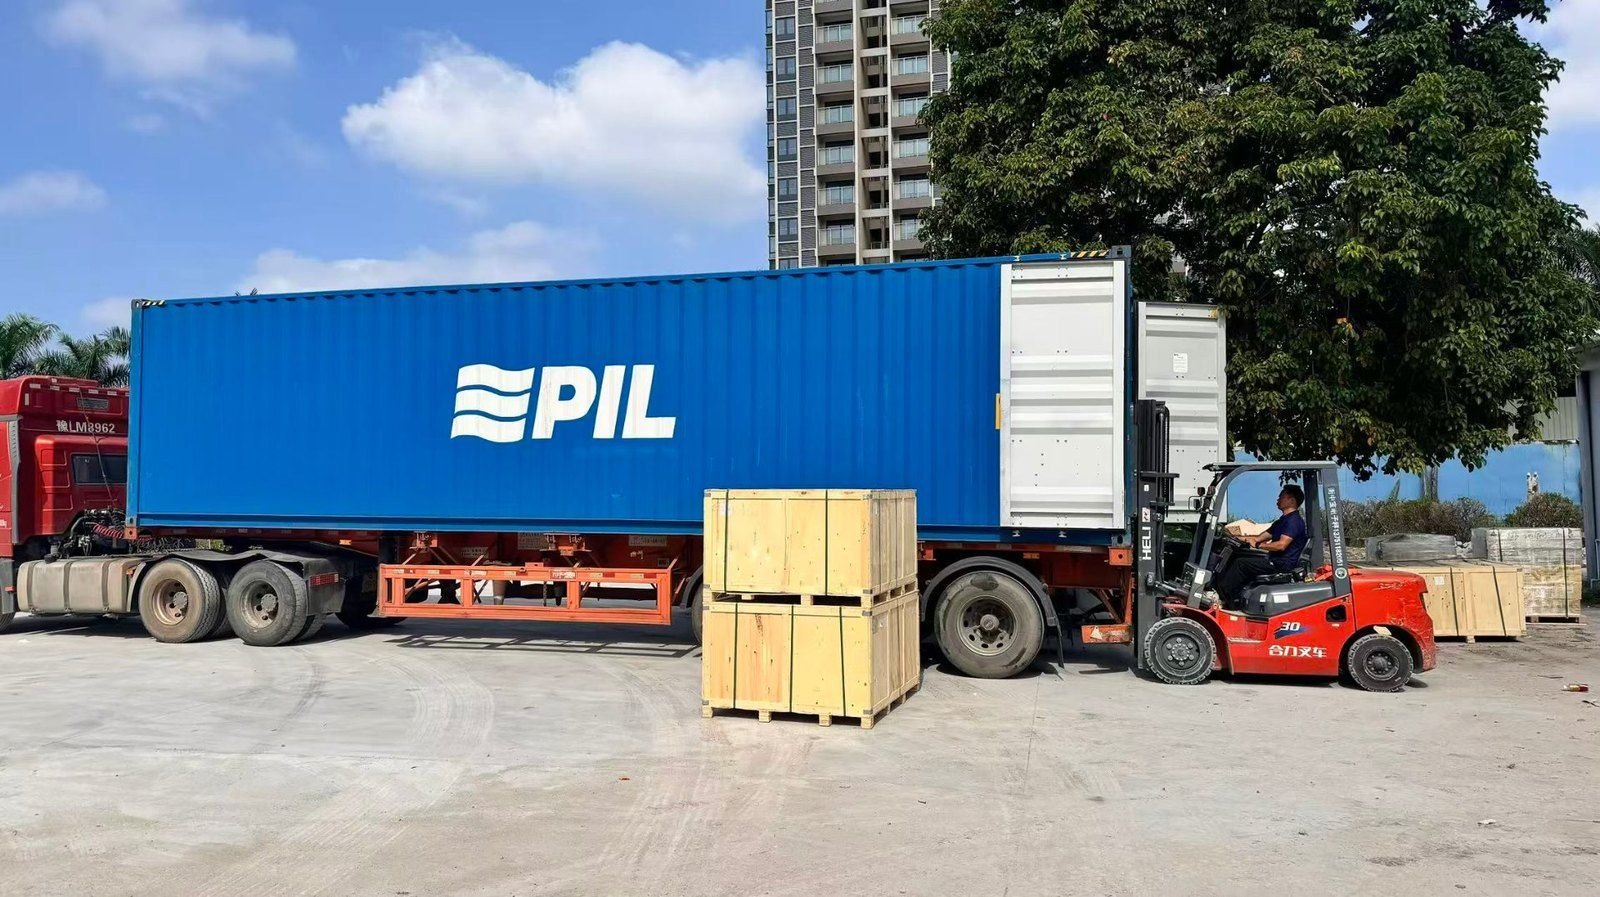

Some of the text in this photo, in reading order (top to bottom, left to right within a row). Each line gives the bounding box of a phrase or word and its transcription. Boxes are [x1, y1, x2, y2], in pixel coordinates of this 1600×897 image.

[531, 364, 677, 439] PIL
[56, 420, 115, 433] 豫LM8962
[1142, 526, 1152, 560] HELI
[1280, 622, 1301, 631] 30
[1268, 645, 1327, 658] 合力叉车
